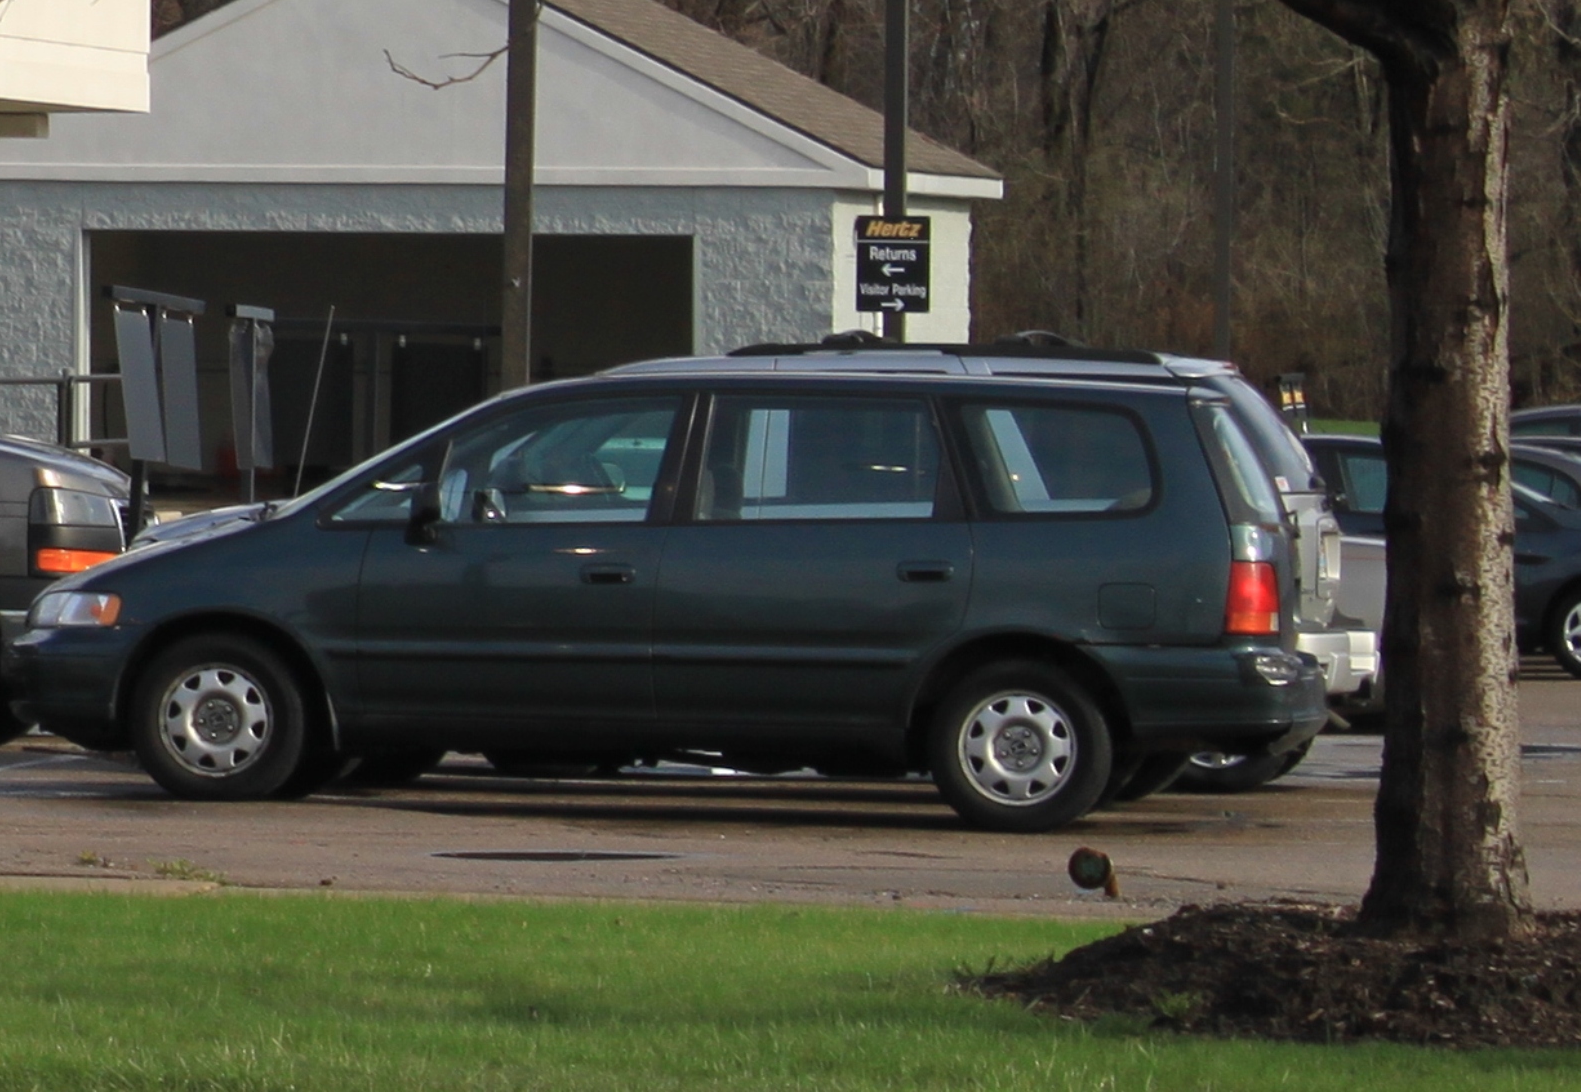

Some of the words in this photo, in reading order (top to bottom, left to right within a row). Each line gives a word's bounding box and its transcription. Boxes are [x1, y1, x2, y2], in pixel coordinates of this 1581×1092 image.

[865, 220, 922, 237] Hertz
[869, 246, 917, 261] Returns
[860, 283, 889, 296] Visitor
[892, 283, 926, 299] Parking
